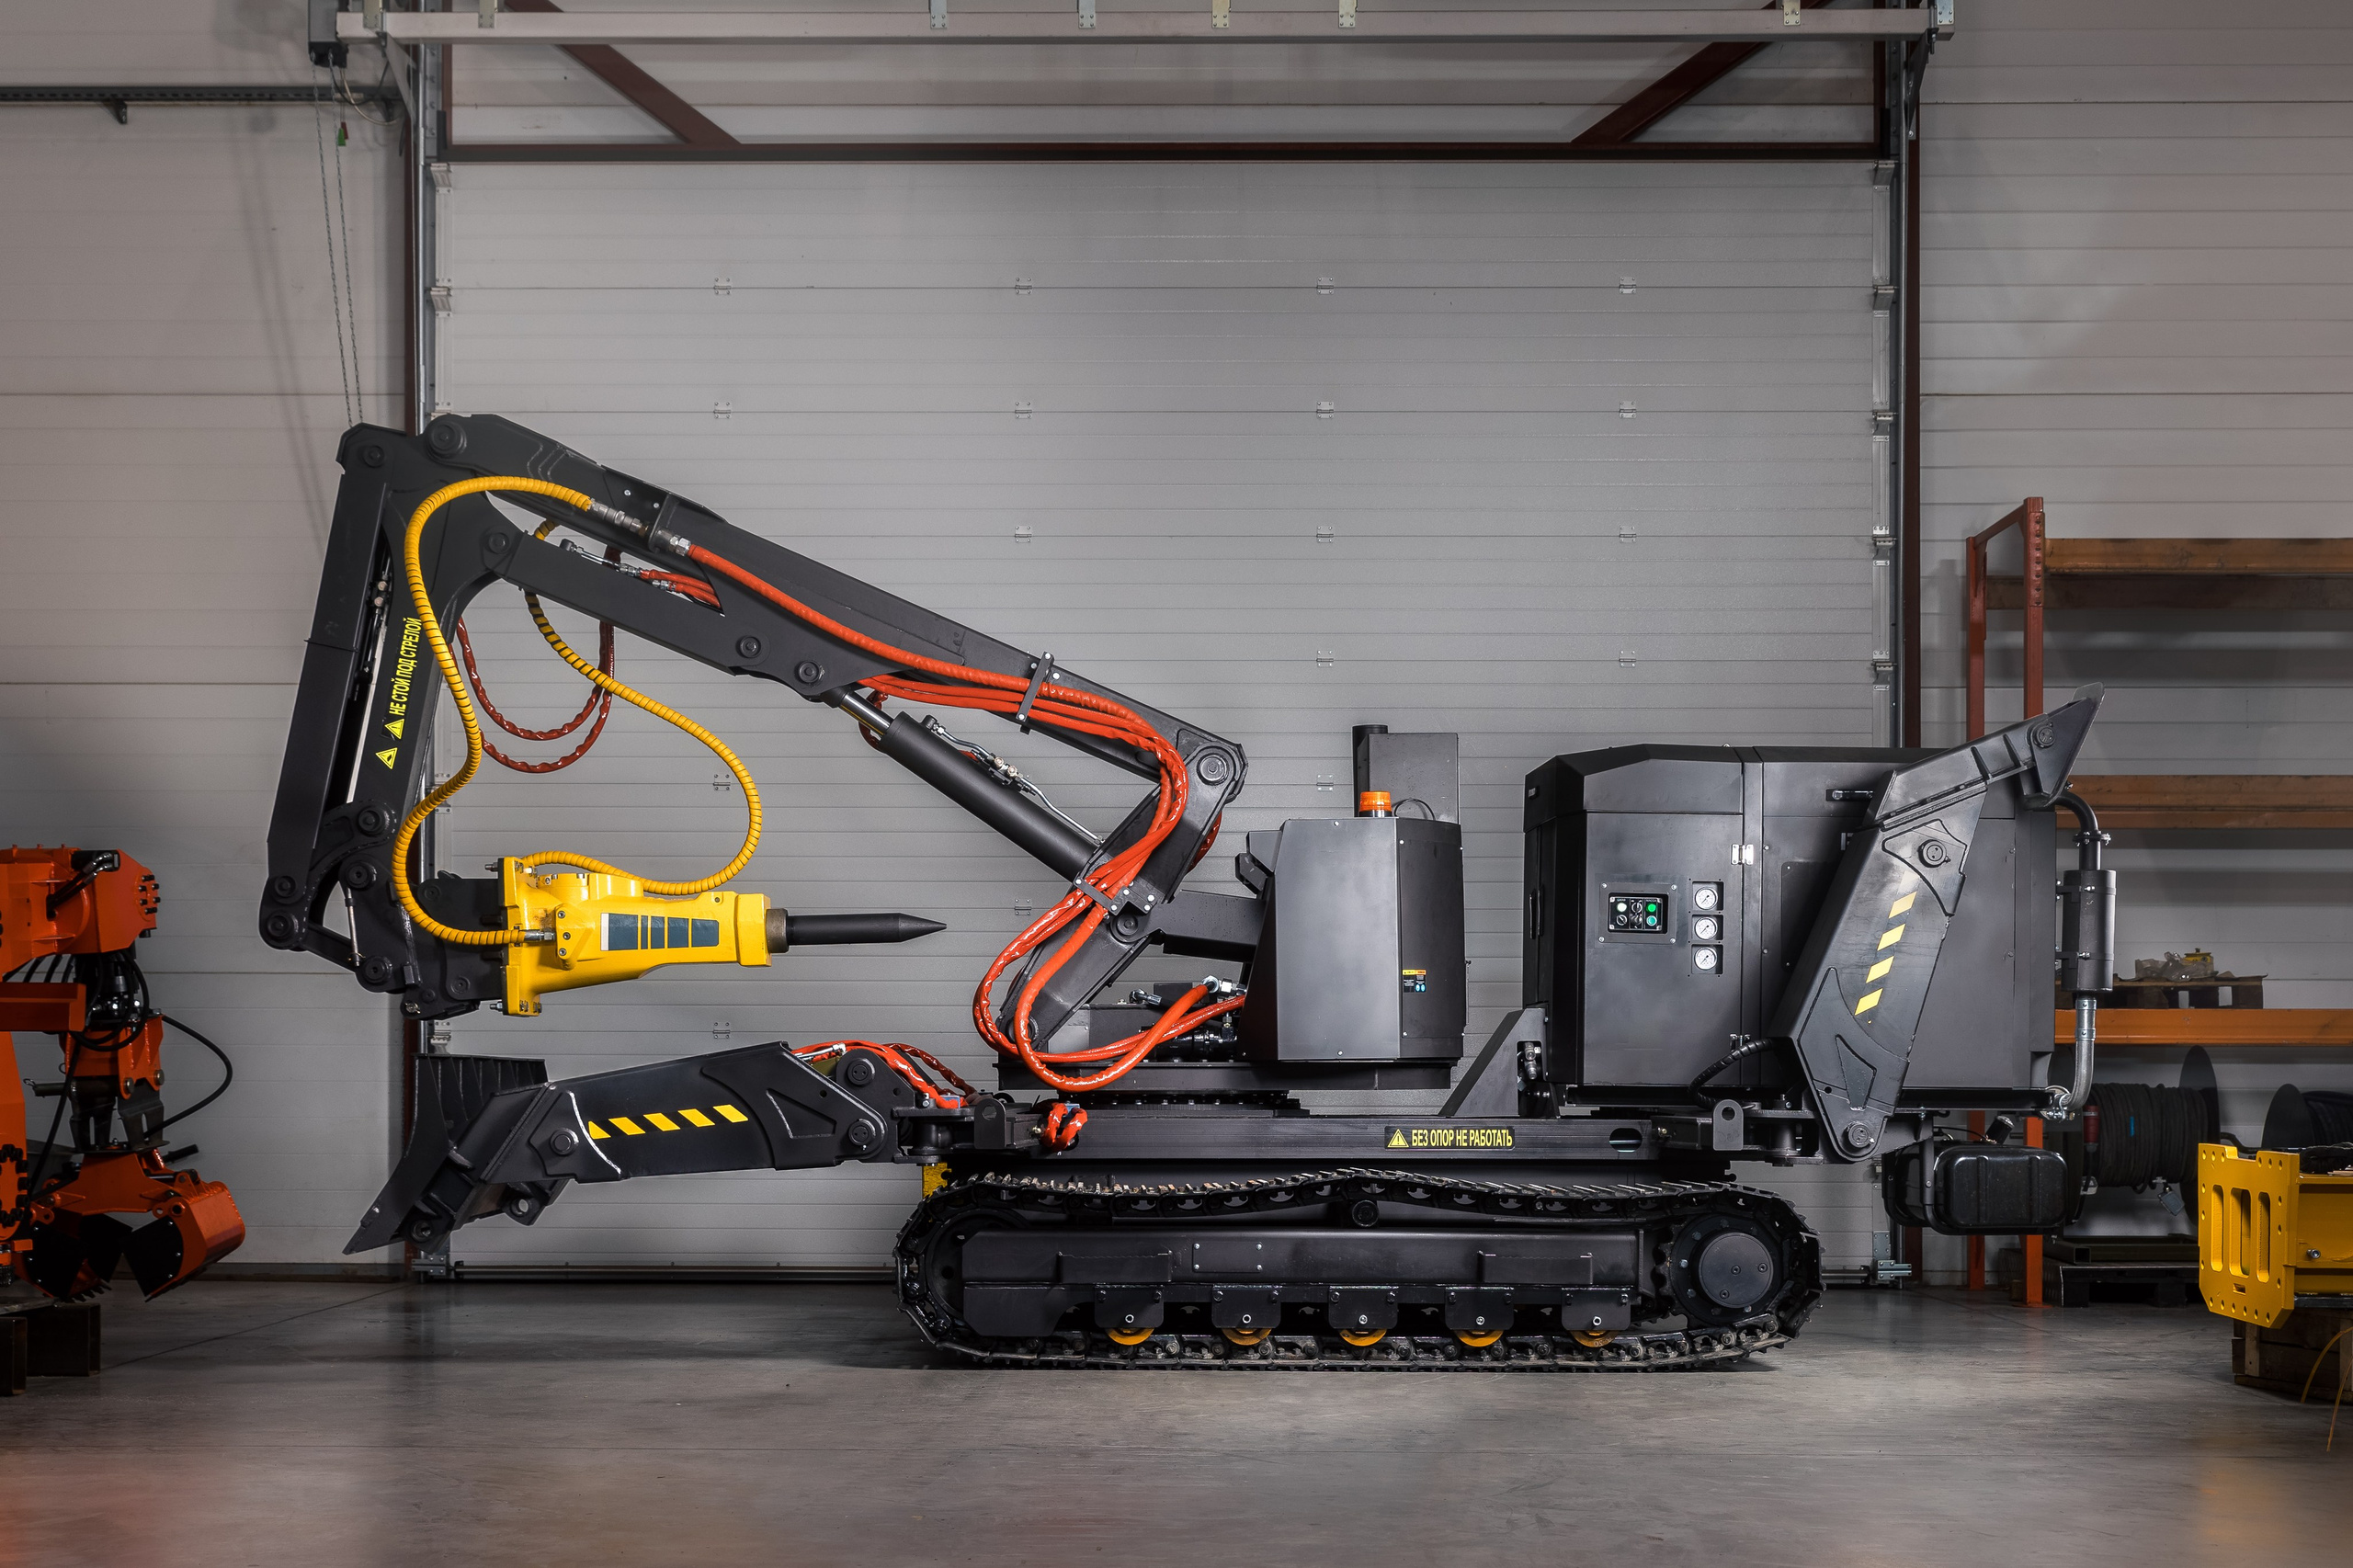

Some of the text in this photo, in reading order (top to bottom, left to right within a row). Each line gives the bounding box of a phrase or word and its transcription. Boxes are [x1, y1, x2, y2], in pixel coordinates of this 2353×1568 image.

[389, 617, 422, 716] НЕ СТОЙ ПОД СТРЕЛОЙ
[1411, 1129, 1513, 1147] БЕЗ ОПОР НЕ РАБОТАТЬ
